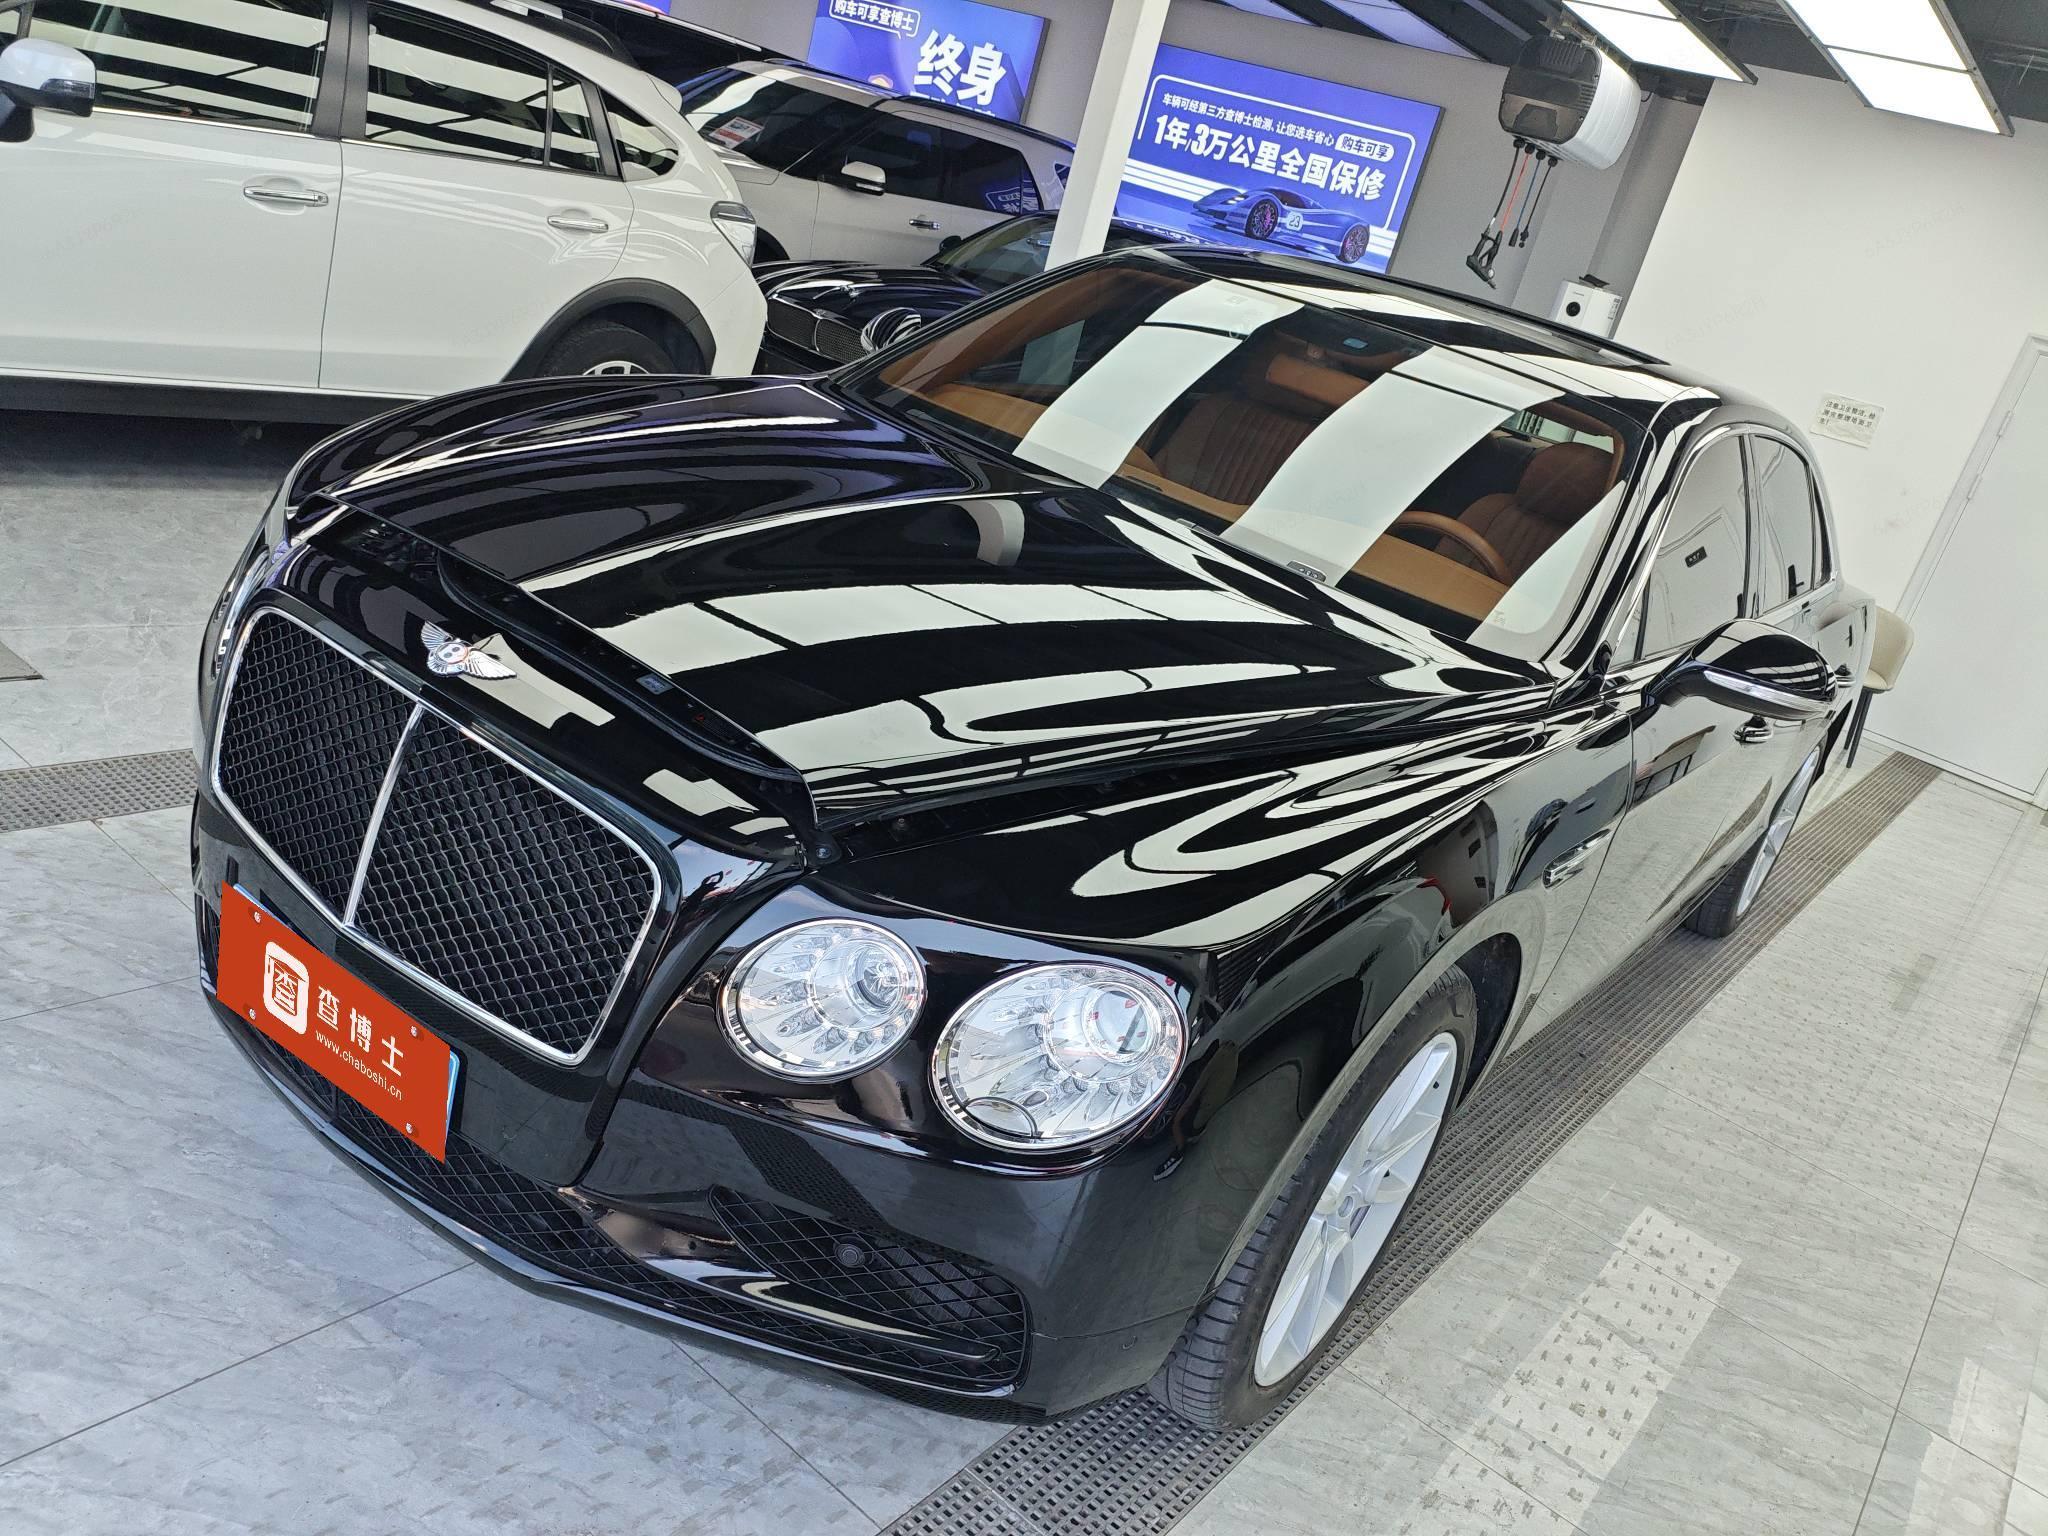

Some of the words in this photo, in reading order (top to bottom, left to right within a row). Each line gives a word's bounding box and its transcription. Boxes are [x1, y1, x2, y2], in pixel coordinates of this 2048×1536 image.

[834, 0, 915, 31] 购车可享查博士
[913, 30, 1006, 105] 终身
[1342, 135, 1390, 159] 购车可享
